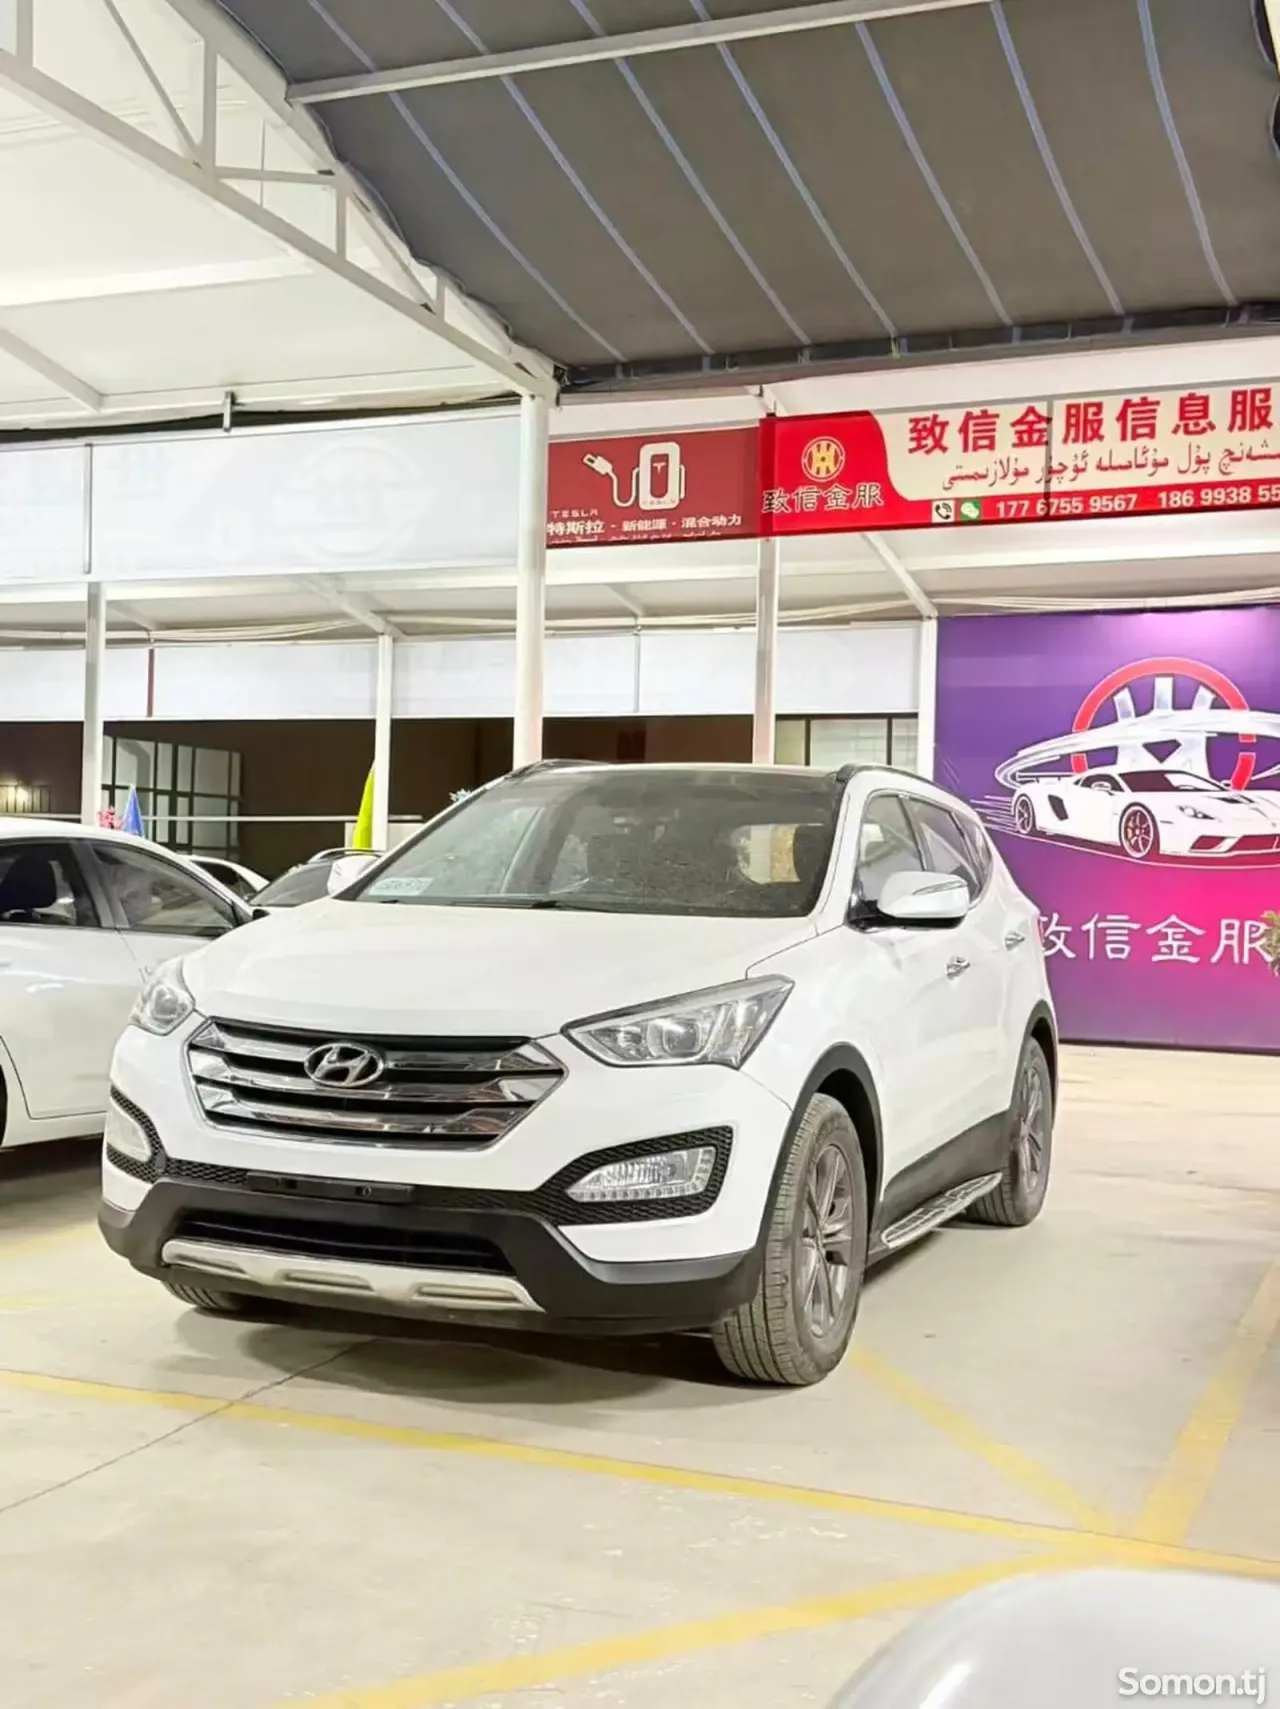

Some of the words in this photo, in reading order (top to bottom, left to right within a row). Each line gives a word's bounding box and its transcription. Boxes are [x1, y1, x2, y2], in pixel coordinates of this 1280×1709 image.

[908, 388, 1274, 455] 致信金服信息服
[551, 508, 599, 518] TESLA
[761, 483, 885, 514] 致信金服
[996, 499, 1030, 518] 177
[1036, 496, 1084, 516] 6755
[1089, 493, 1138, 513] 9567
[1158, 489, 1194, 508] 186
[1200, 486, 1252, 505] 9938
[547, 520, 605, 536] 特斯拉
[681, 513, 742, 529] 混合动力
